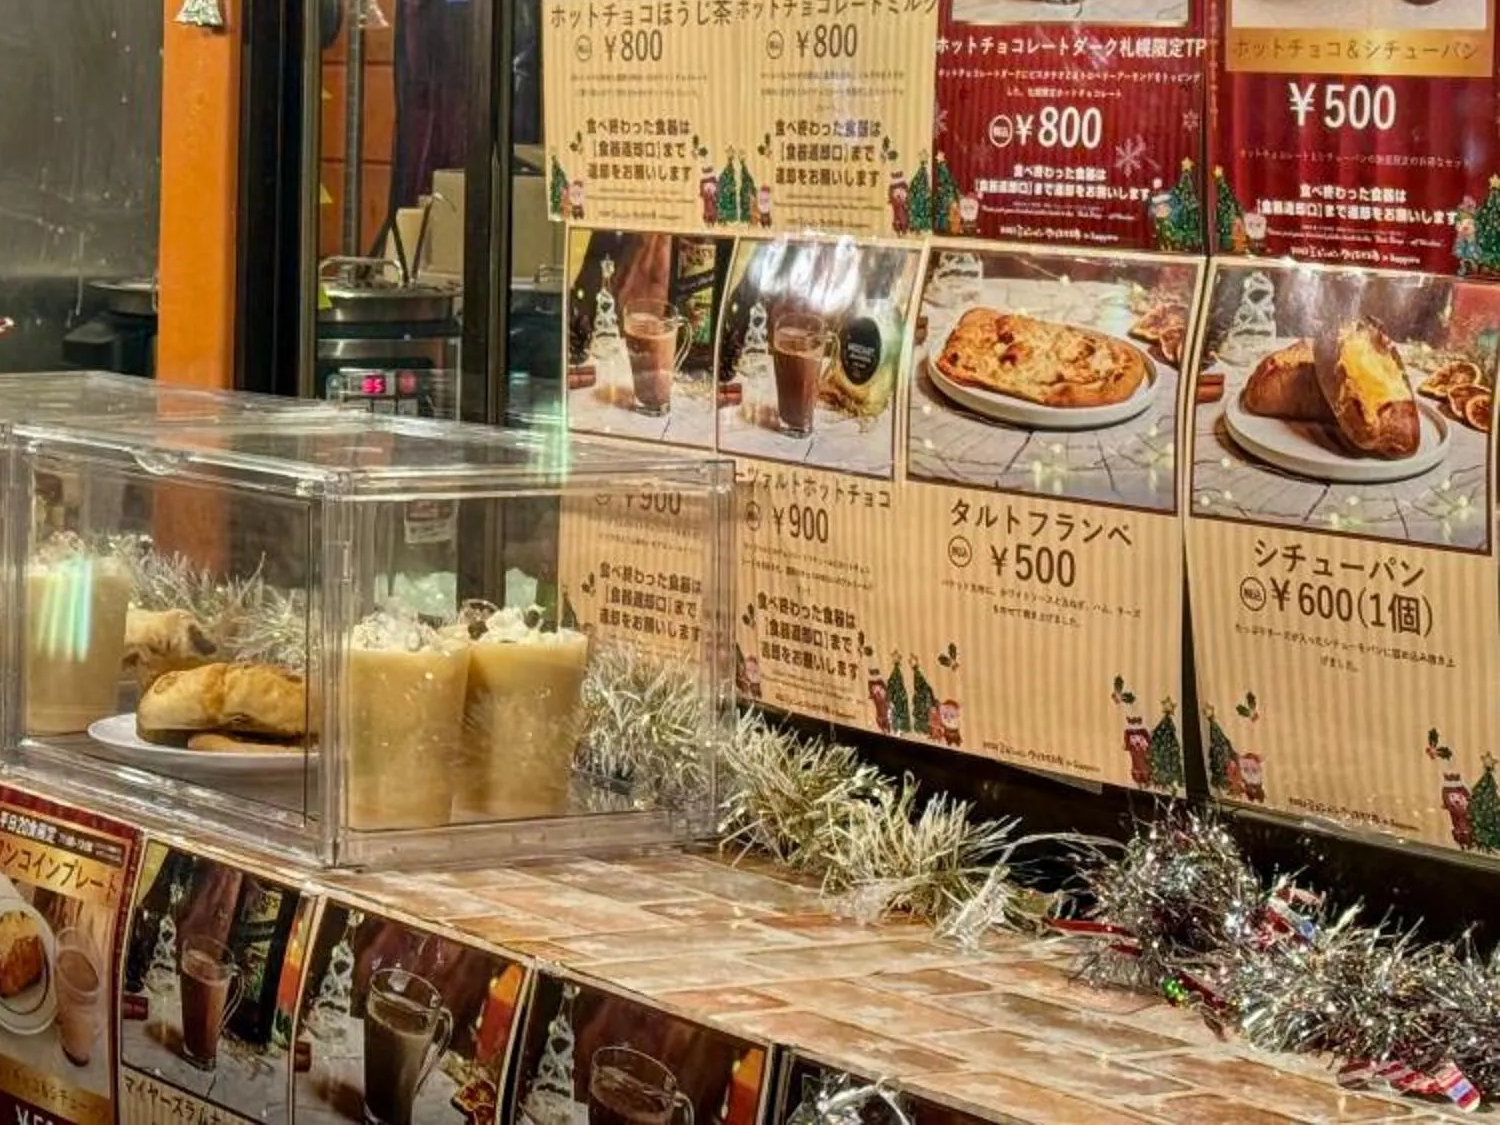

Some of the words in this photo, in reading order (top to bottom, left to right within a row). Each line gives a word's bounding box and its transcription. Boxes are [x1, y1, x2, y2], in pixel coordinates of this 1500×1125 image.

[551, 0, 733, 29] ホットチョコほうじ茶
[604, 29, 663, 62] ¥800
[796, 23, 858, 58] ¥800
[1288, 82, 1397, 131] ¥500
[586, 117, 690, 136] 食べ終わった食器は
[775, 119, 881, 137] 食べ終わった食器は
[1015, 105, 1103, 148] ¥800
[587, 163, 692, 181] 返却をお願いします
[775, 167, 880, 187] 返却をお願いします
[1013, 164, 1107, 181] 食べ終わった食器は
[1299, 183, 1407, 203] 食べ終わった食器は
[773, 503, 829, 543] ¥900
[951, 498, 1132, 546] タルトフランベ
[990, 543, 1076, 587] ¥500
[1253, 539, 1424, 587] シチューパン
[757, 591, 855, 629] 食べ終わった食器は
[1269, 576, 1433, 638] ¥600(1個)
[761, 641, 858, 680] 返却をお願いします
